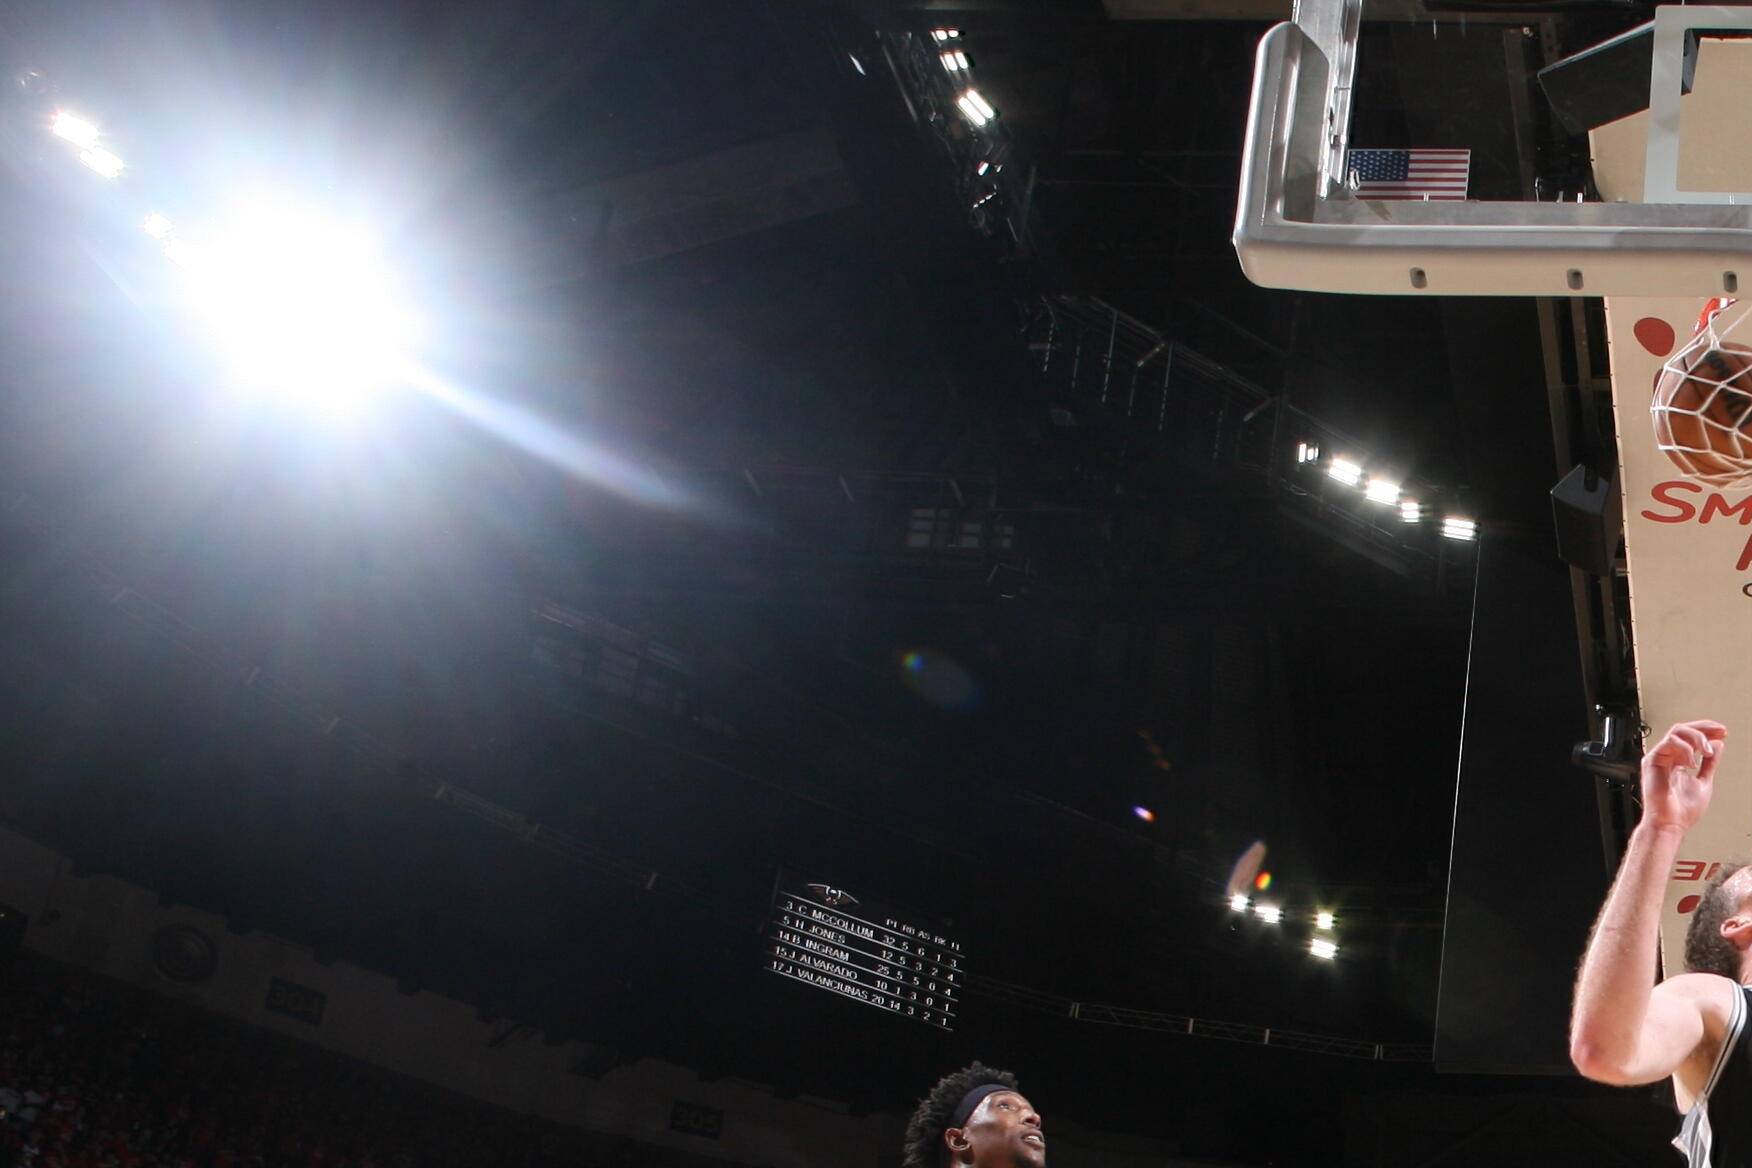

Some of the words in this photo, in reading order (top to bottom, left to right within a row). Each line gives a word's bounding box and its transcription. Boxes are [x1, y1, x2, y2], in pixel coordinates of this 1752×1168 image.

[809, 925, 846, 944] JONES
[805, 939, 850, 962] INGRAM
[799, 954, 859, 980] ALVARADO
